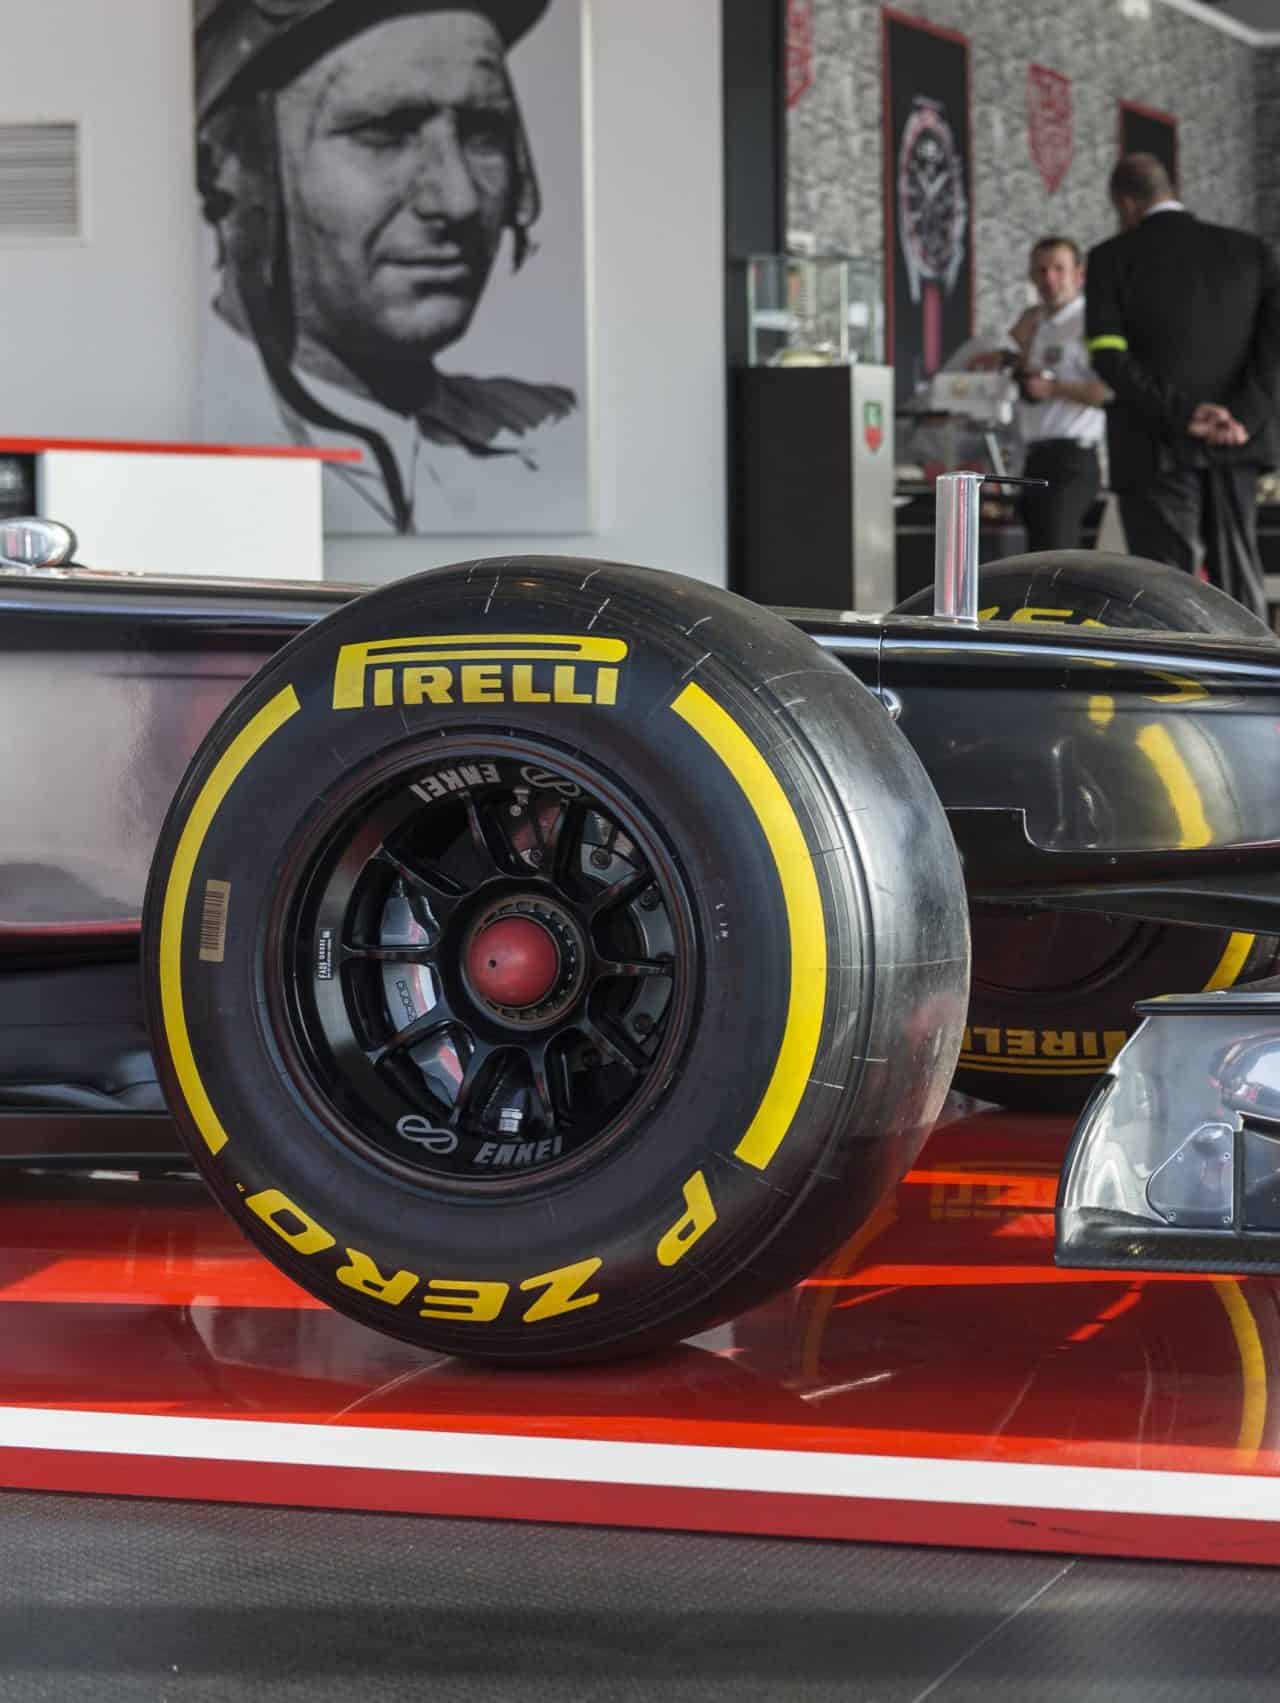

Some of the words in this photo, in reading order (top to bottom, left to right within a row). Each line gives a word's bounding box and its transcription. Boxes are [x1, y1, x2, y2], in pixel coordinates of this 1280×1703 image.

[332, 634, 629, 708] PIRELLI
[408, 762, 502, 803] ENKEI
[472, 1135, 563, 1165] ENKEI
[244, 1188, 602, 1323] ZERO
[656, 1171, 718, 1268] P
